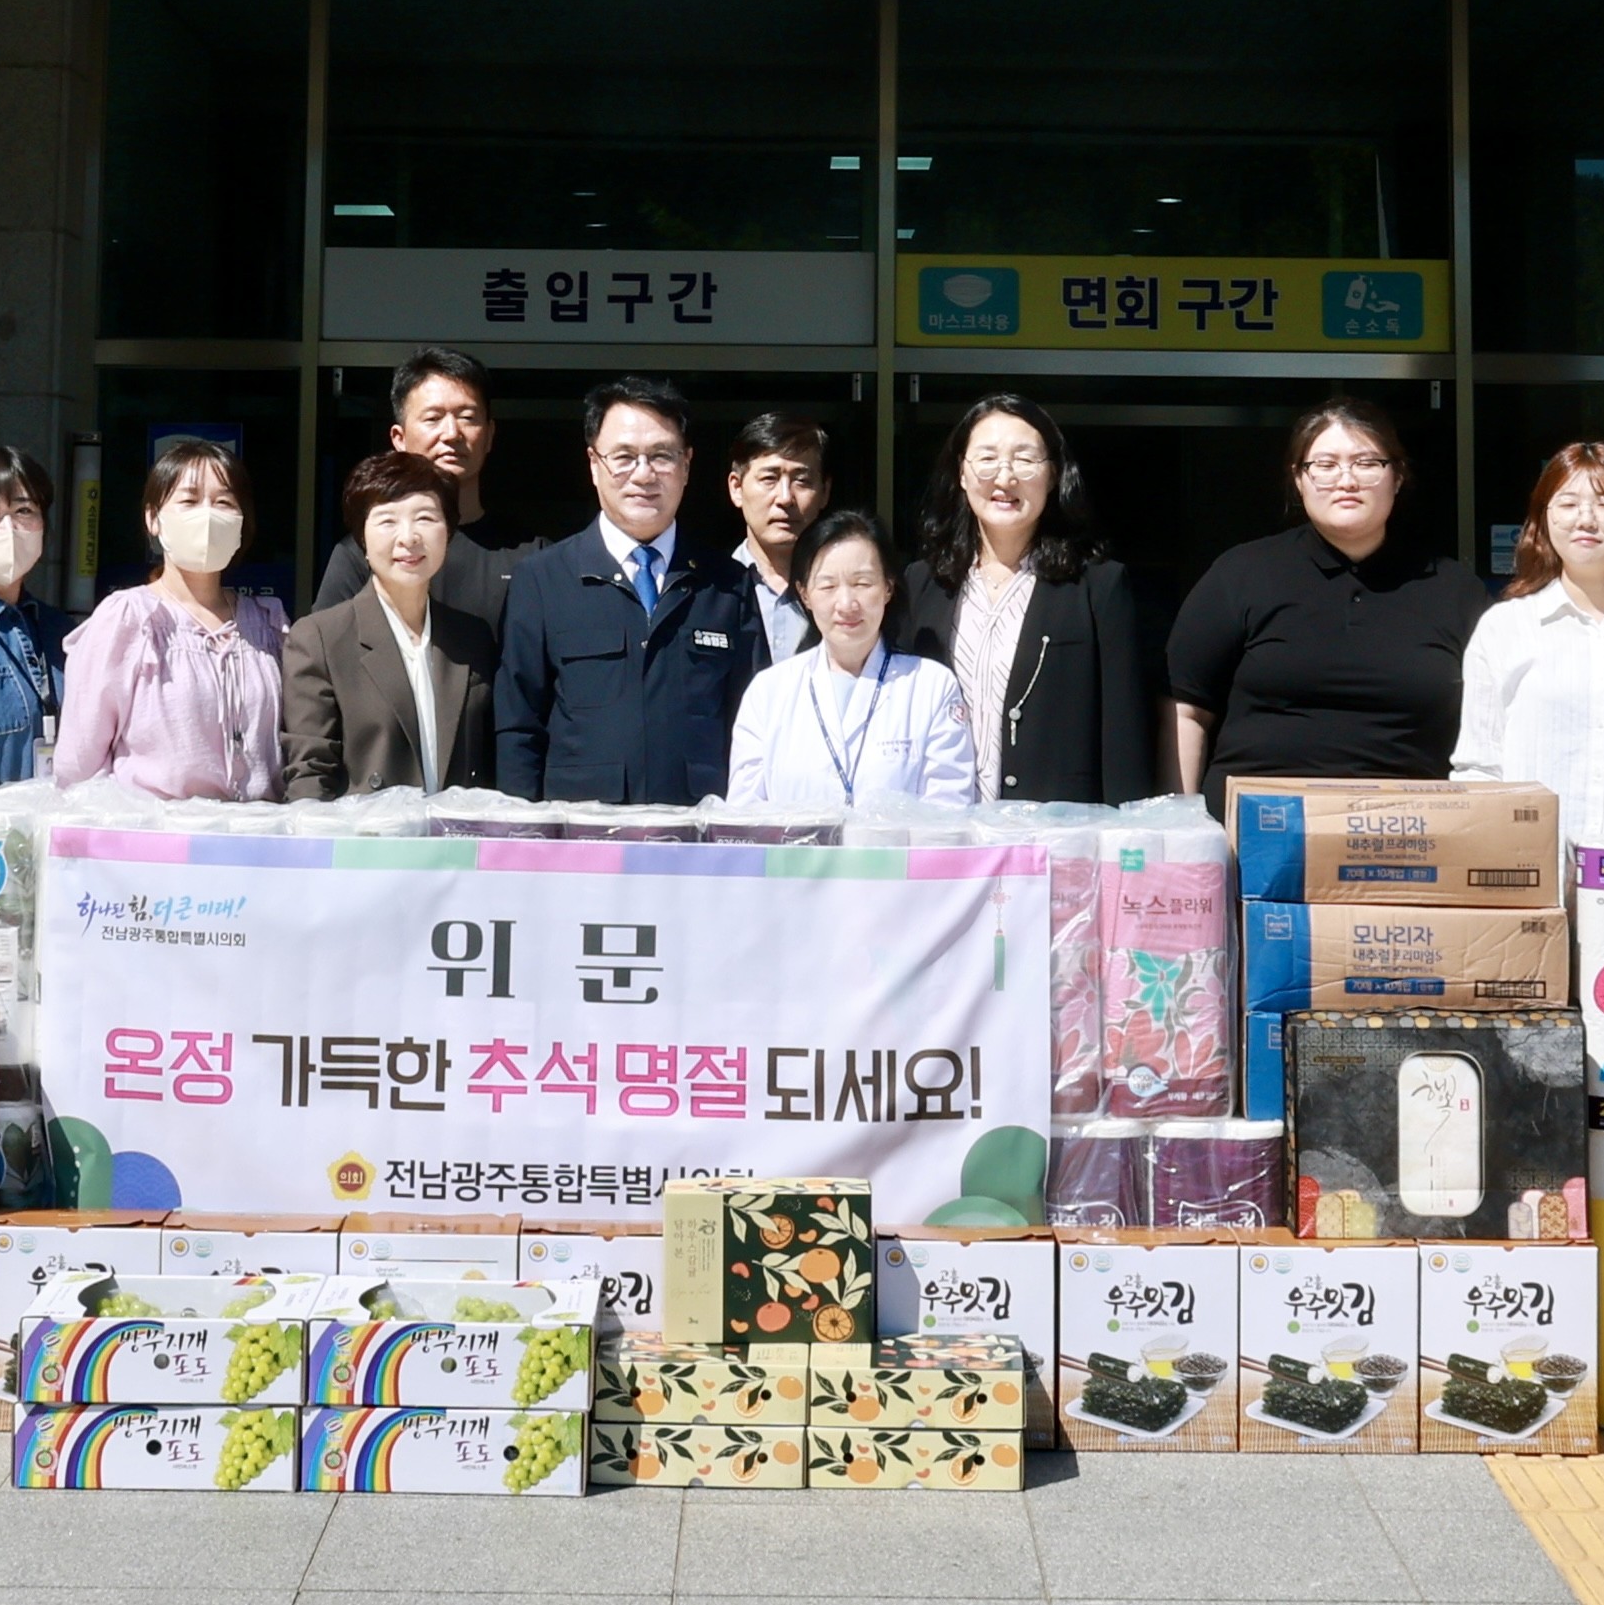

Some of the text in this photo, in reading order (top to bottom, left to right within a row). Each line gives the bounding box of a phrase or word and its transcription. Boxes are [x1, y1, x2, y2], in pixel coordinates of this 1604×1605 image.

[483, 268, 718, 324] 출입구간
[1061, 275, 1279, 332] 면회 구간
[1347, 815, 1428, 835] 모나리자
[1346, 838, 1385, 852] 내추럴
[77, 891, 126, 937] 하나된
[154, 896, 174, 926] 더
[174, 896, 193, 920] 큰
[197, 896, 247, 919] 미래!
[101, 925, 246, 947] 전남광주통합특별시의회
[1353, 925, 1434, 946] 모나리자
[1352, 949, 1391, 964] 내추럴
[102, 1027, 234, 1107] 온정
[251, 1032, 452, 1114] 가득한
[764, 1044, 983, 1123] 되세요!
[338, 1170, 364, 1185] 의회
[939, 1268, 959, 1284] 고흥
[1122, 1273, 1143, 1289] 고흥
[1302, 1274, 1323, 1290] 고흥
[1481, 1274, 1503, 1289] 고흥
[920, 1275, 1011, 1320] 우주맛김
[1103, 1281, 1196, 1327] 우주맛김
[1283, 1282, 1376, 1327] 우주맛김
[1463, 1281, 1555, 1326] 우주맛김
[173, 1353, 212, 1376] 포도
[463, 1354, 503, 1378] 포도
[166, 1439, 205, 1462] 포도
[456, 1440, 494, 1463] 포도
